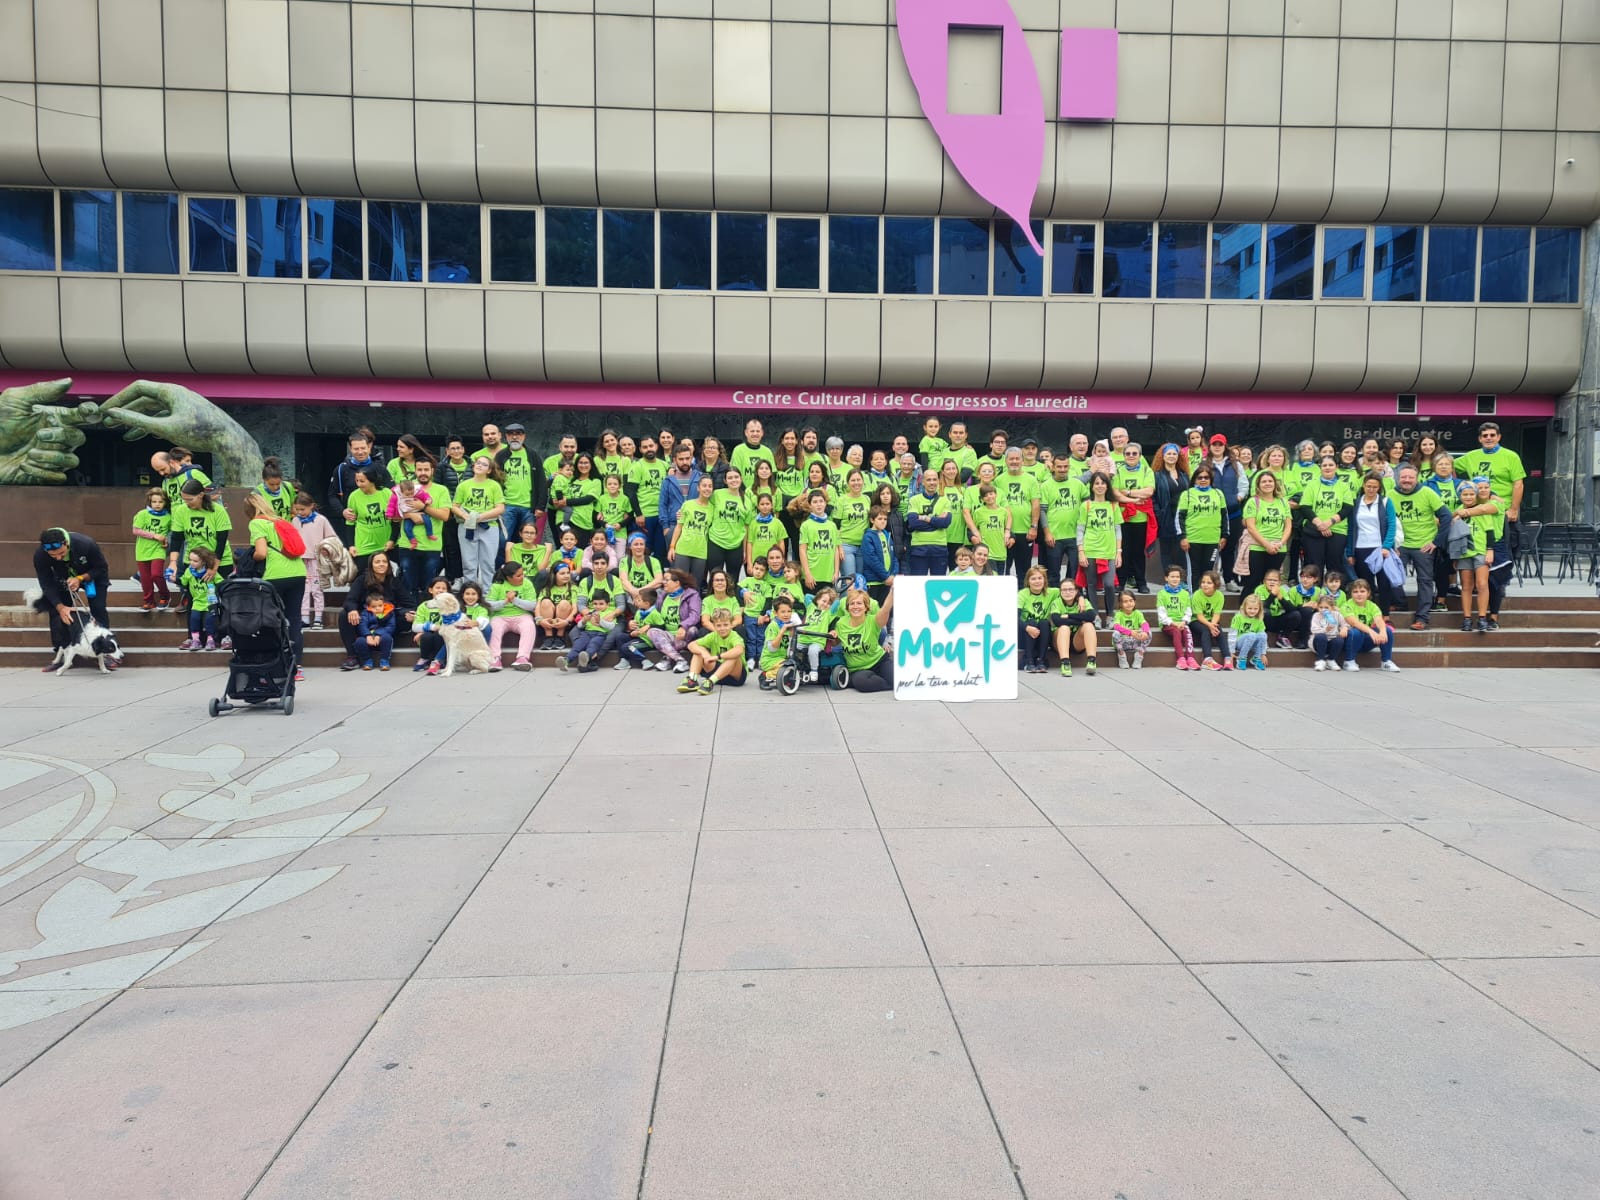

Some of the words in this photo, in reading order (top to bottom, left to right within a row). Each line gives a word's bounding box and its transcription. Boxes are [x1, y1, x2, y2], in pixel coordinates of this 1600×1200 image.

[732, 390, 792, 405] Centre
[798, 391, 867, 406] Cultural
[872, 392, 878, 406] i
[882, 392, 904, 407] de
[910, 393, 1008, 411] Congressos
[1015, 394, 1088, 411] Lauredià
[1372, 426, 1397, 440] del
[898, 613, 1016, 683] Mou-te
[896, 679, 914, 692] per
[914, 672, 926, 687] la
[926, 675, 949, 687] teva
[953, 672, 984, 687] salut
